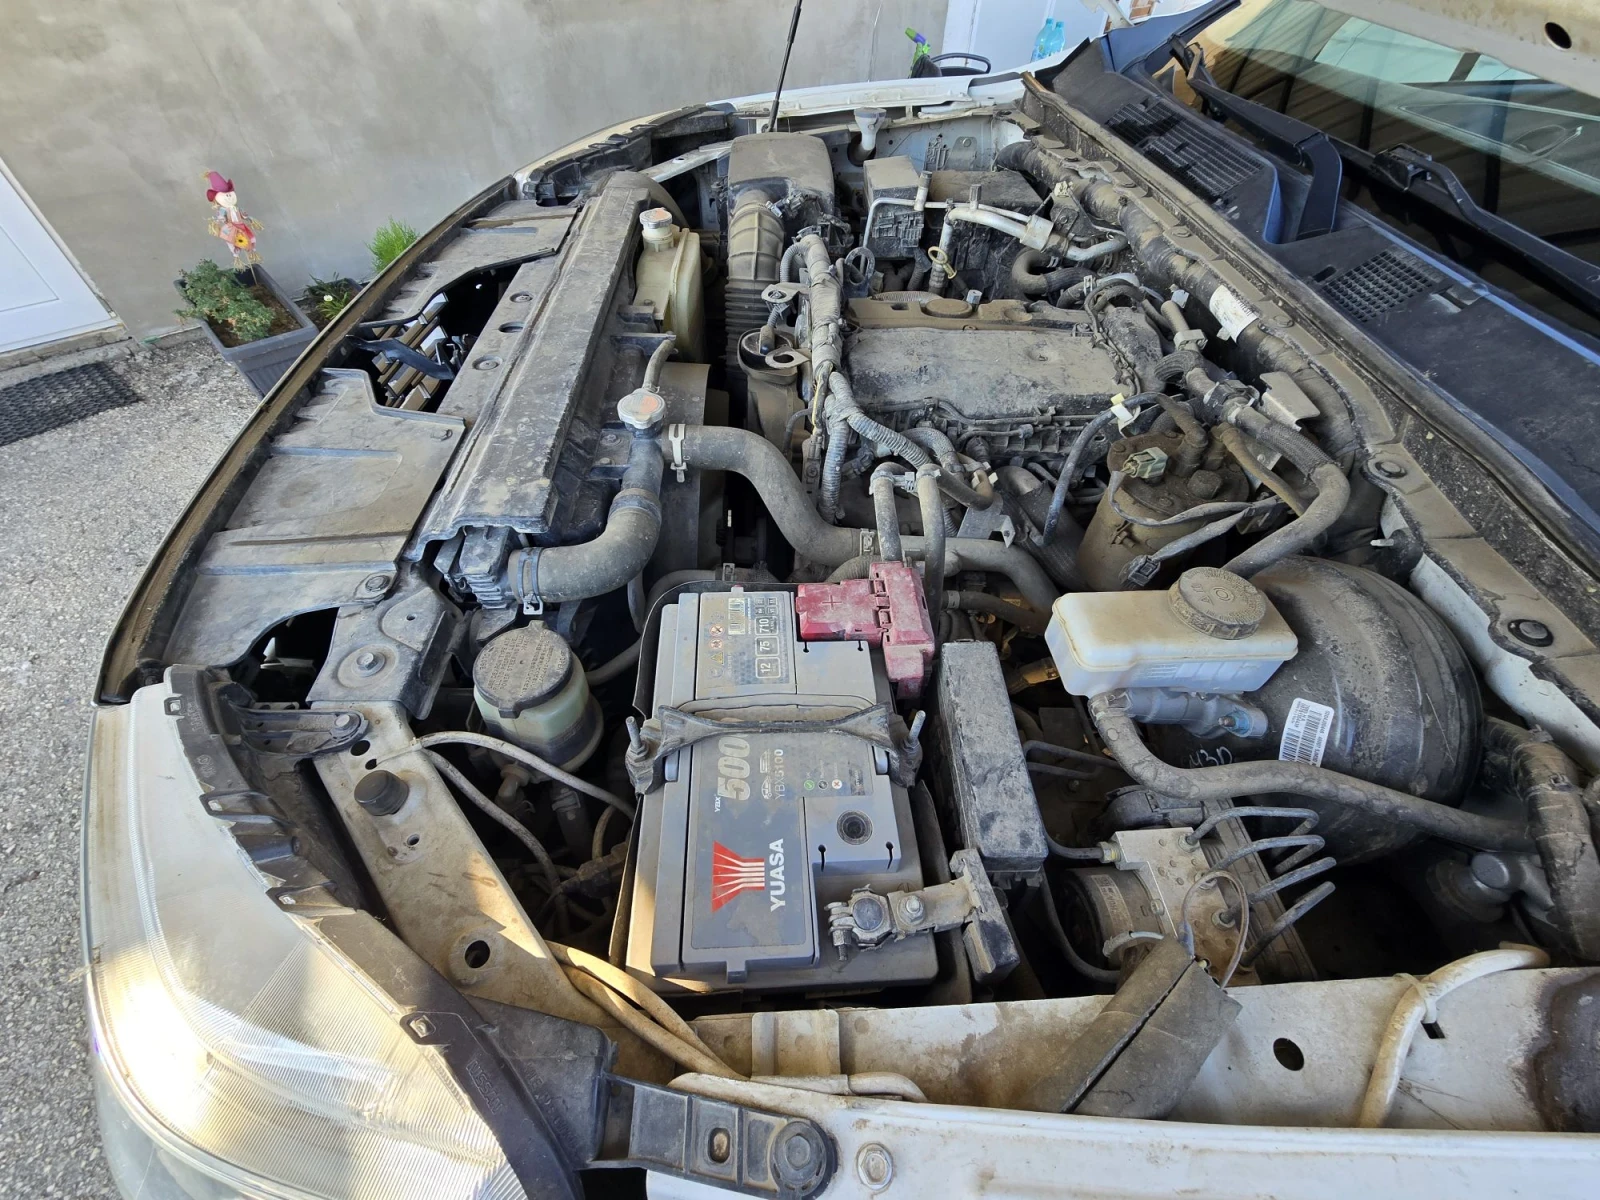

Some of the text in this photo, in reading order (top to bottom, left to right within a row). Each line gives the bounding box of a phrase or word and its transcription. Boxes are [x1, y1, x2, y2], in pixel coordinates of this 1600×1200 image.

[759, 618, 769, 633] 710
[760, 641, 770, 652] 75
[760, 662, 771, 674] 12
[717, 734, 751, 801] 500
[774, 749, 786, 800] YBX5100
[769, 838, 786, 912] YUASA
[465, 1059, 501, 1115] NISSAN
